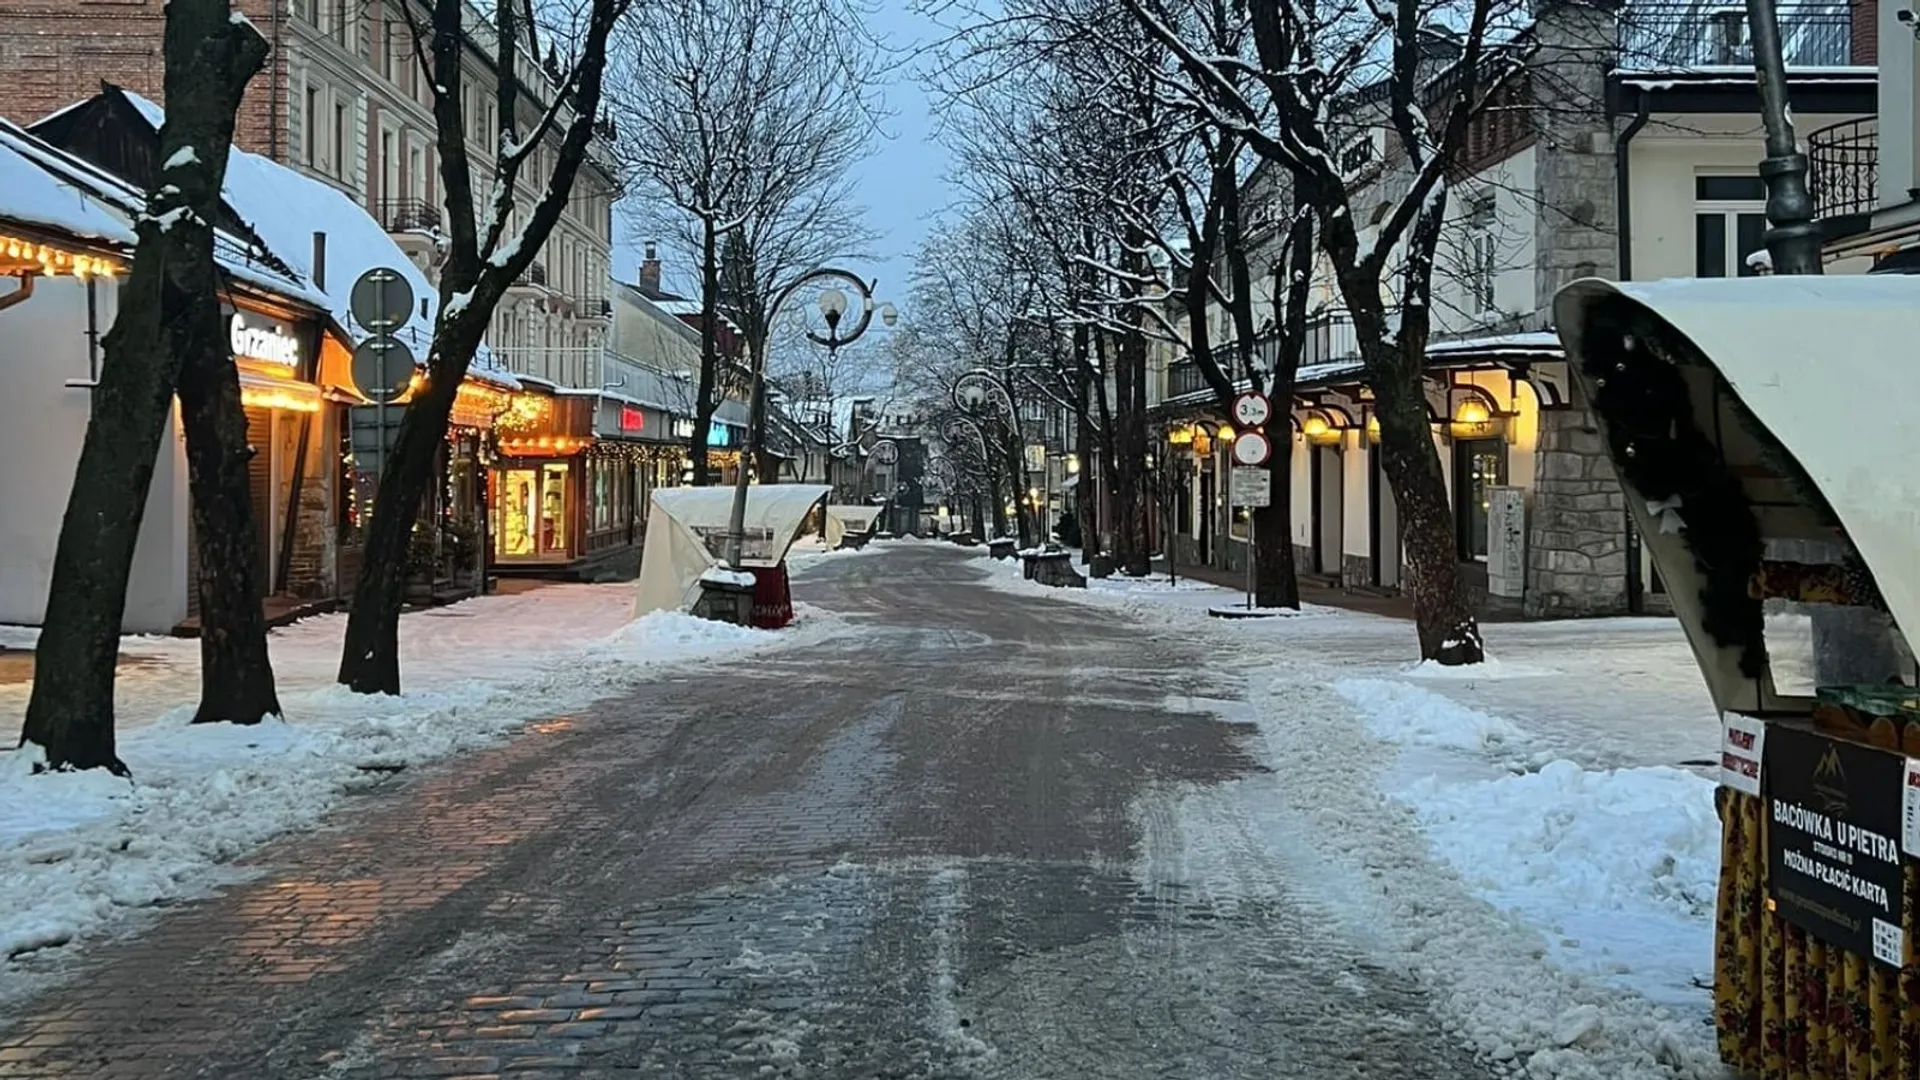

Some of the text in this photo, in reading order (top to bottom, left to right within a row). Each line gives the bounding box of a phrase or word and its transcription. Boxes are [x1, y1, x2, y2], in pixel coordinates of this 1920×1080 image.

[230, 313, 299, 367] Grzaniec
[1773, 798, 1899, 866] BACÓWKA U PIETRA
[1783, 848, 1815, 876] MOŻNA
[1815, 862, 1852, 892] PŁACIĆ
[1852, 874, 1889, 912] KARTĄ
